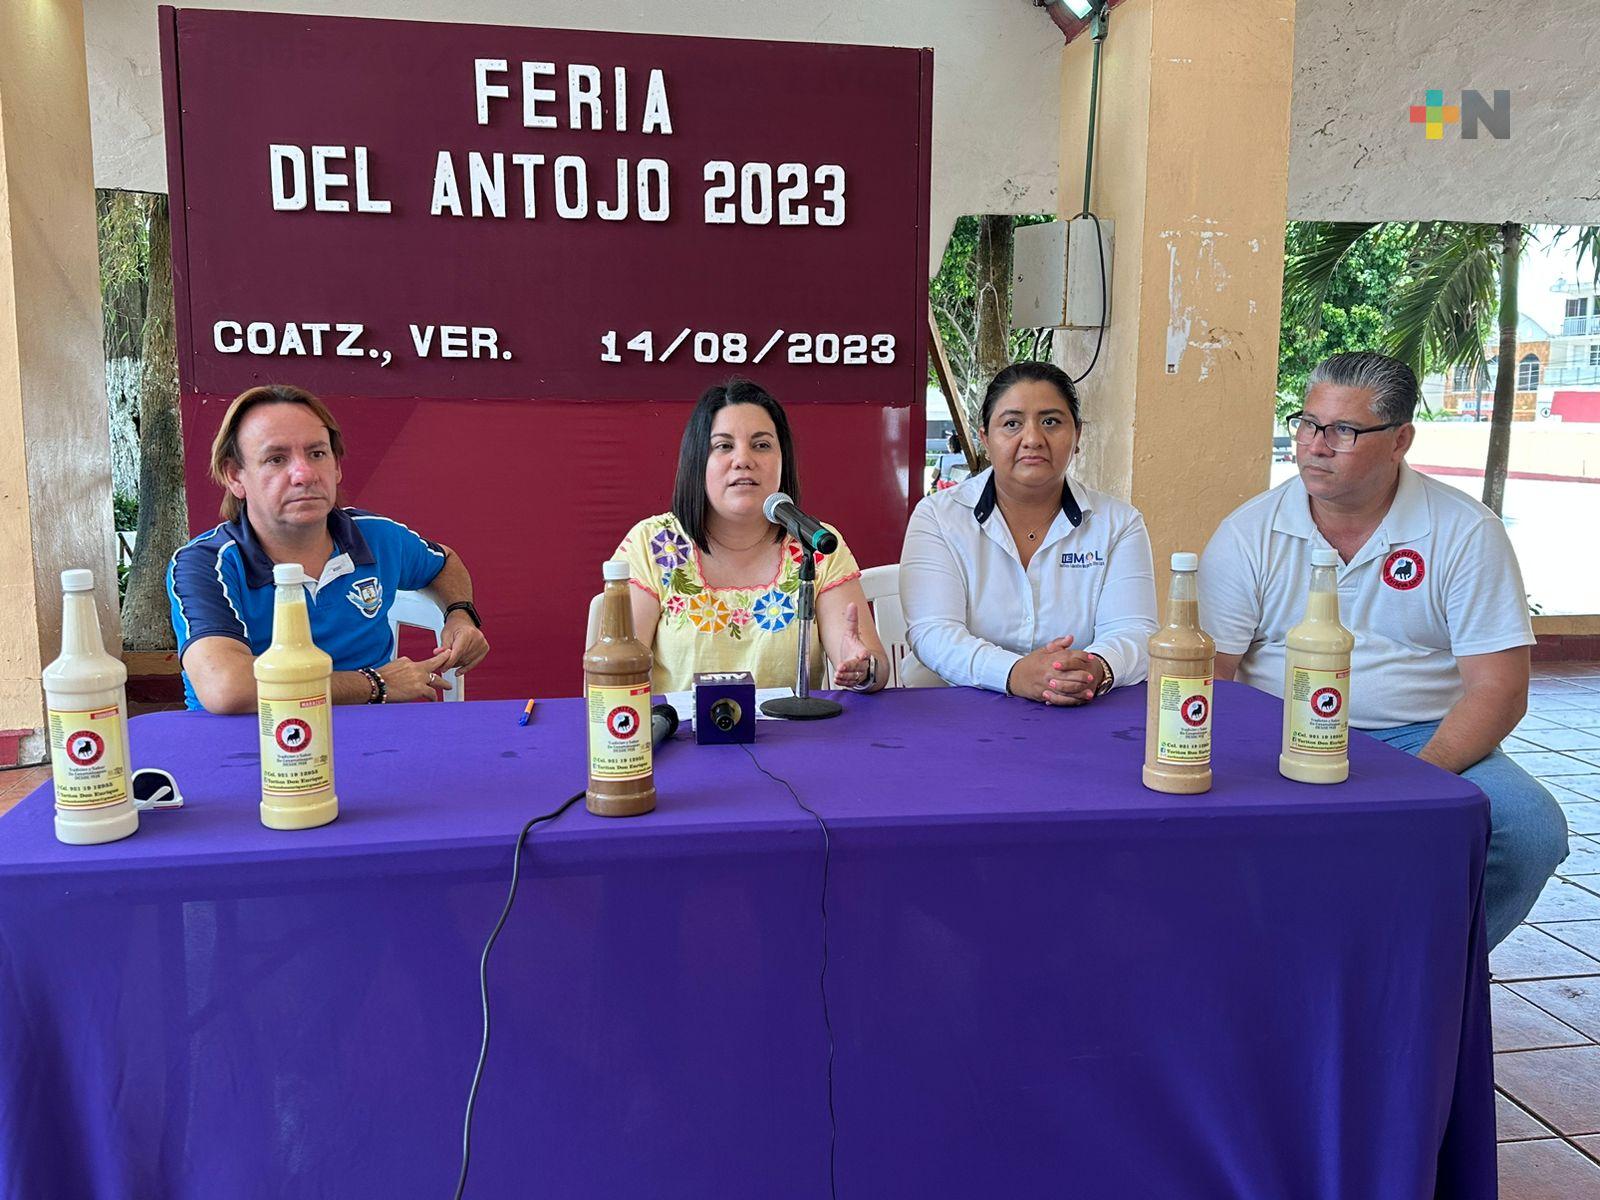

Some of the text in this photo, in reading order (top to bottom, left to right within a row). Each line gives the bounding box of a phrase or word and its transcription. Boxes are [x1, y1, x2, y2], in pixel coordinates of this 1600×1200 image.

[473, 58, 673, 135] FERIA
[268, 143, 847, 227] DEL ANTOJO 2023
[213, 319, 513, 368] COATZ., VER.
[600, 328, 897, 366] 14/08/2023
